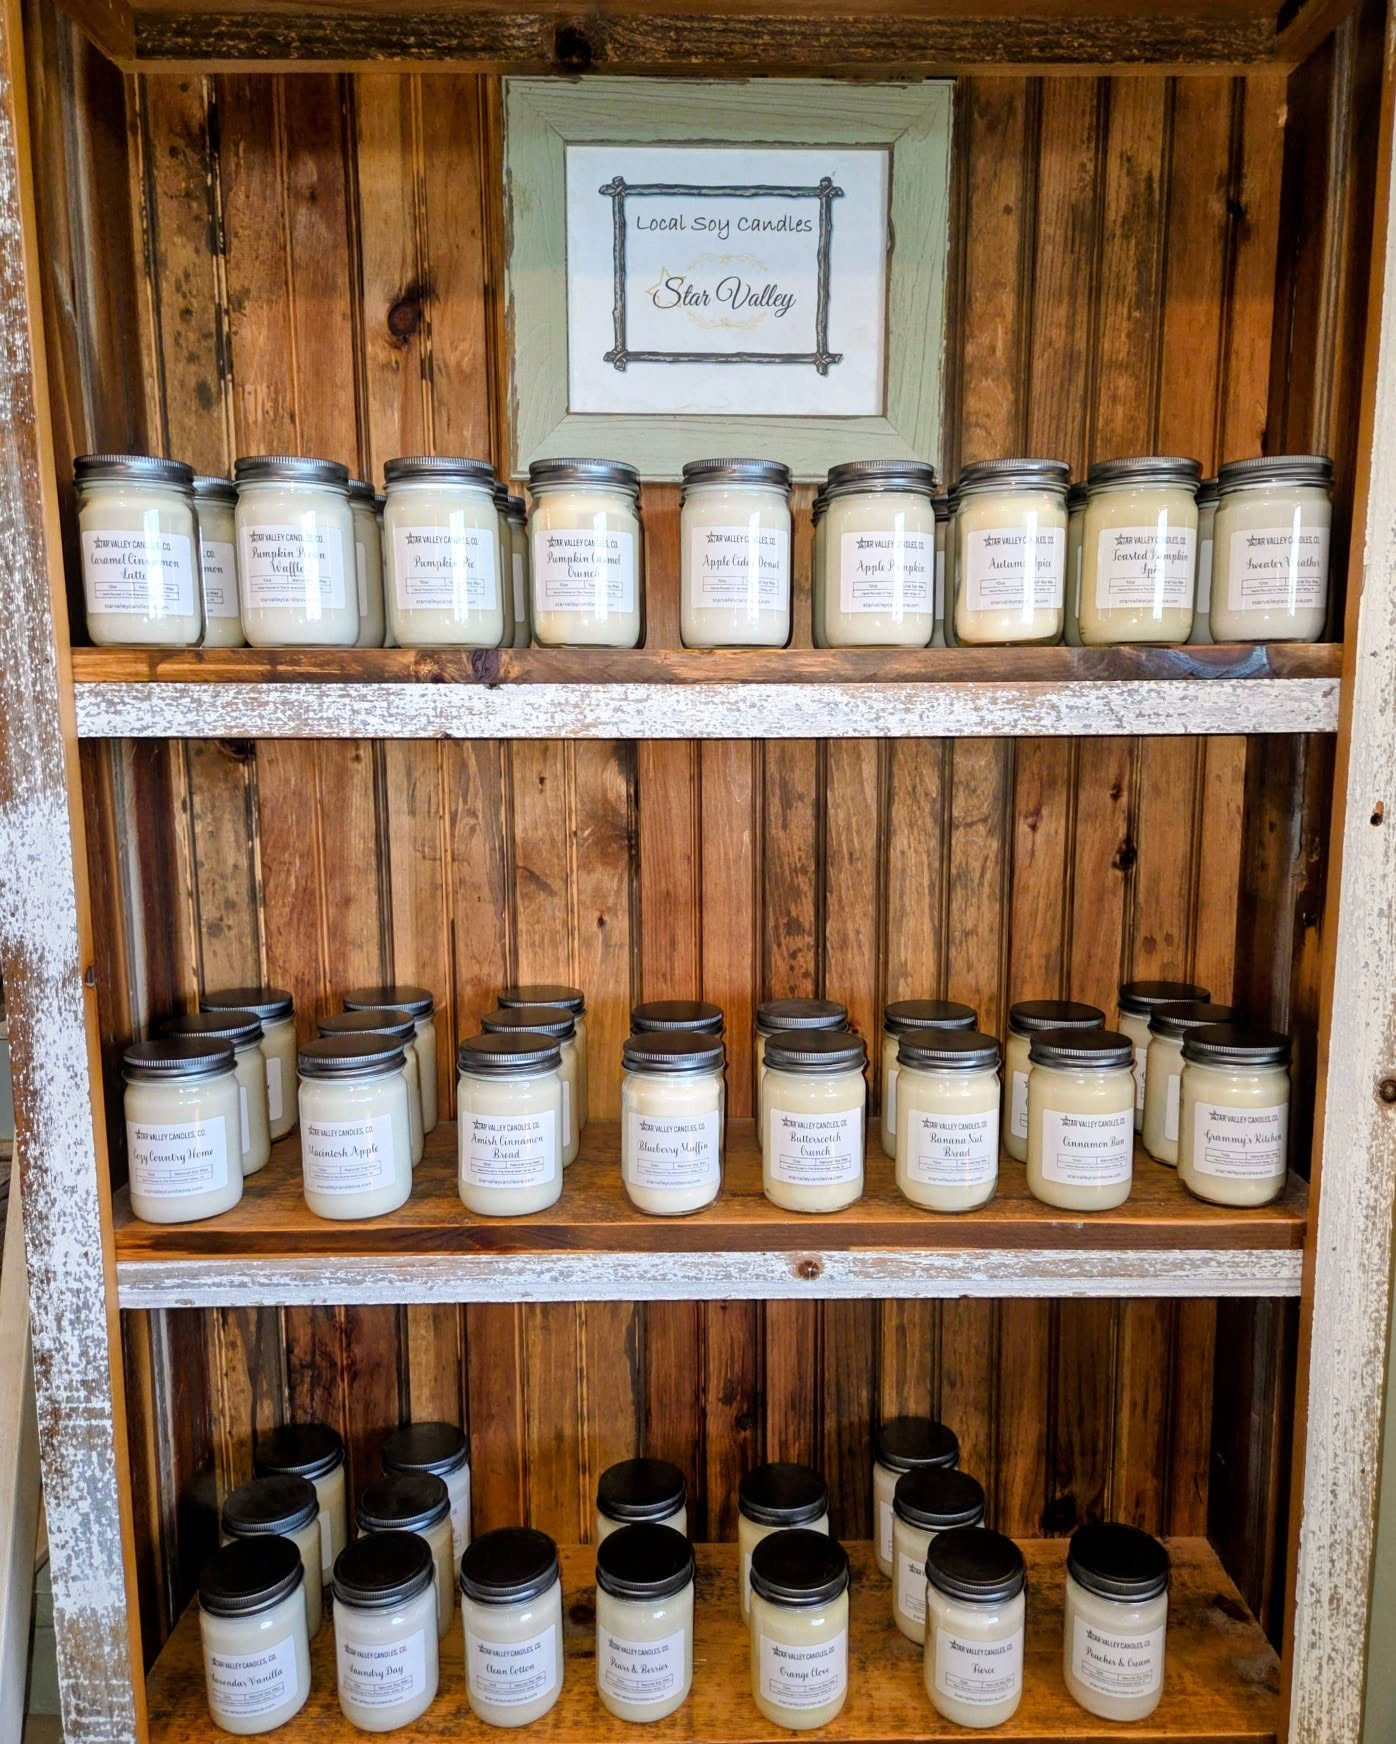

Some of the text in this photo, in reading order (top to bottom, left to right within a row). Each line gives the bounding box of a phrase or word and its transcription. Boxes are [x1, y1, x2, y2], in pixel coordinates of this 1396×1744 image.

[636, 214, 812, 239] Local Soy Candles
[652, 276, 796, 318] Star Valley
[724, 535, 743, 543] VALLEY
[1266, 536, 1287, 545] VALLEY
[1112, 549, 1147, 561] Toasted
[414, 555, 457, 572] Pumpki
[703, 554, 730, 570] Apple
[732, 554, 753, 567] Cide
[857, 560, 884, 575] Apple
[989, 558, 1026, 569] Autum
[1079, 1120, 1097, 1128] VALLEY
[1227, 1115, 1246, 1123] VALLEY
[655, 1125, 673, 1133] VALLEY
[939, 1122, 957, 1130] VALLEY
[472, 1133, 497, 1146] Amish
[790, 1131, 841, 1144] Butterscotch
[350, 1143, 378, 1159] Apple
[493, 1148, 520, 1159] Bread
[800, 1145, 831, 1157] Crunch
[1118, 1658, 1125, 1667] &
[631, 1664, 639, 1673] &
